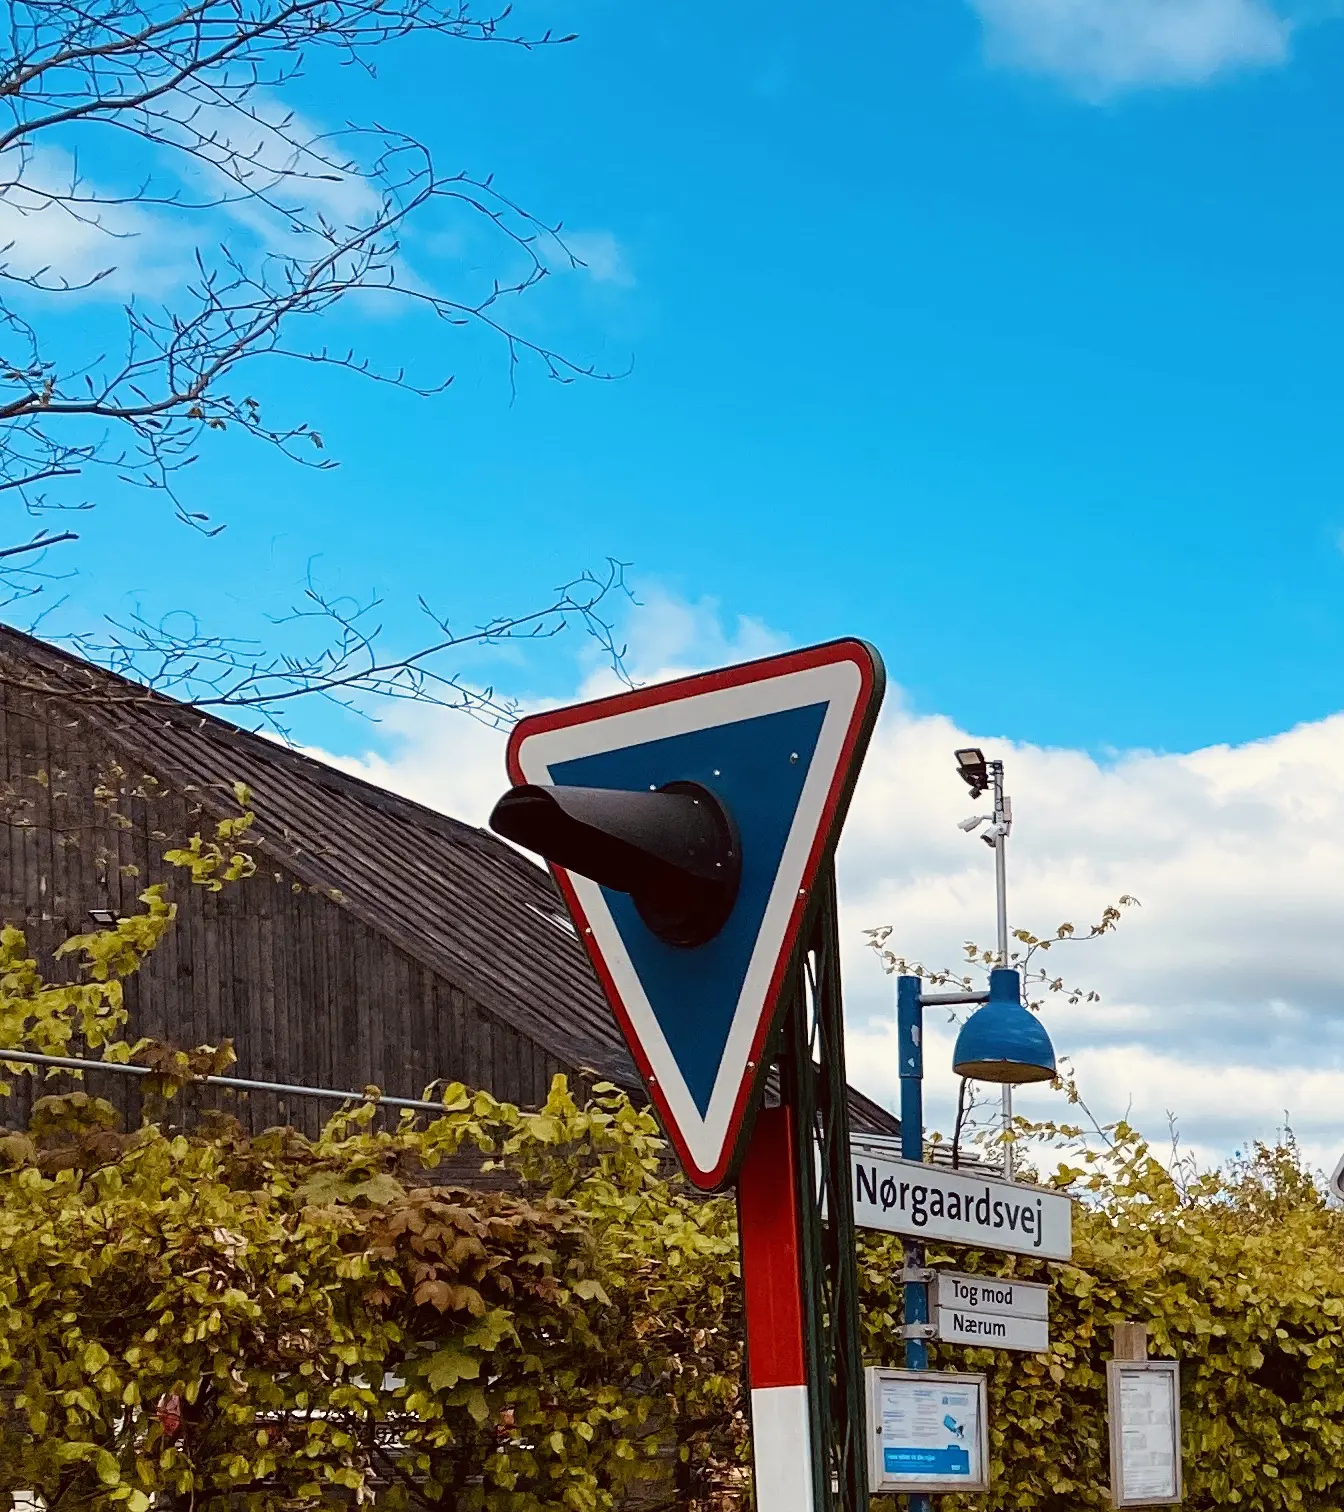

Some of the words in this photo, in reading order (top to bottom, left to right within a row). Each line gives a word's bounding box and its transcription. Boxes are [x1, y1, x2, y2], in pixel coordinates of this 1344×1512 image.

[855, 1163, 1043, 1247] Nørgaardsvej
[952, 1280, 978, 1306] Tog
[981, 1286, 1013, 1305] mod
[953, 1313, 1006, 1337] Nærum
